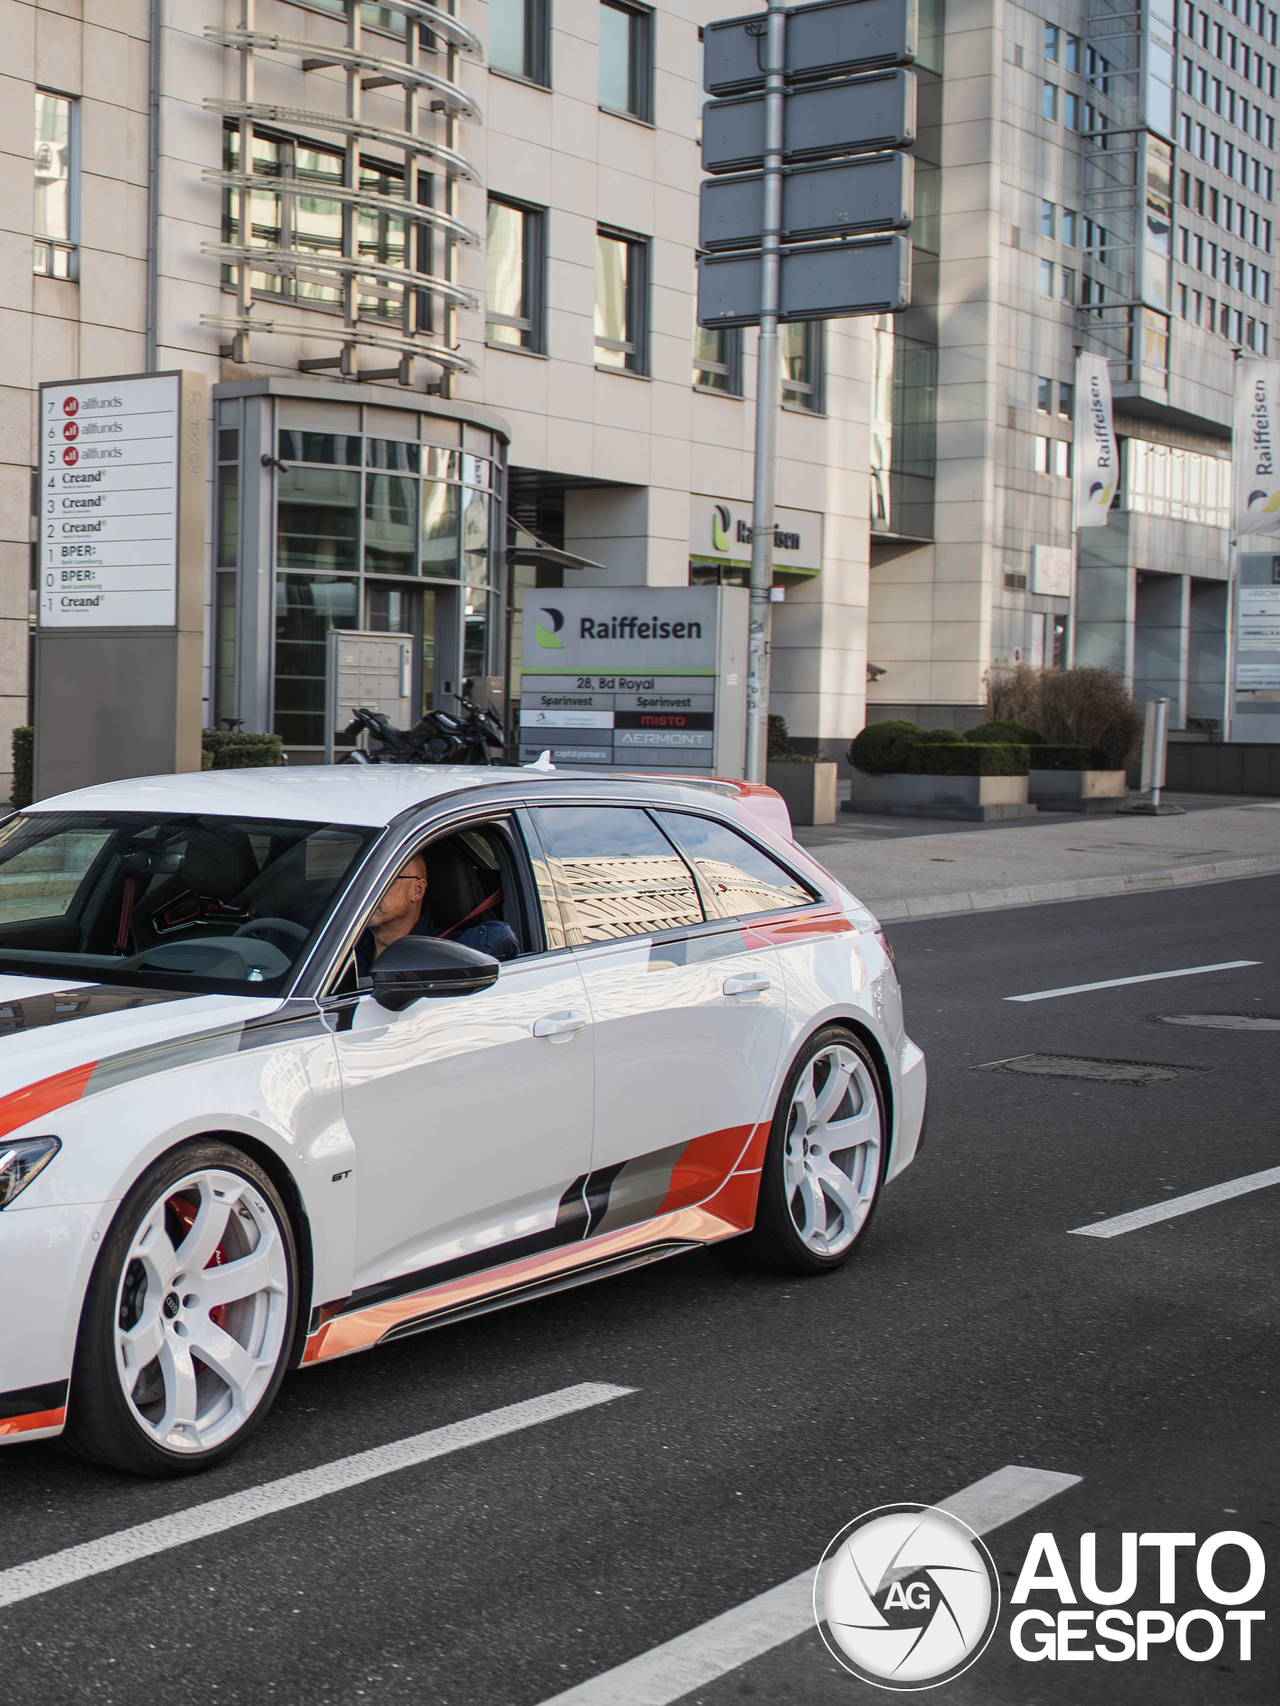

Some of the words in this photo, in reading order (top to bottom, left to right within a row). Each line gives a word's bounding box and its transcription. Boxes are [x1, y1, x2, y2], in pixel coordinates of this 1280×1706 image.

[48, 402, 55, 413] 7
[81, 396, 122, 410] allfunds
[1091, 376, 1110, 467] Raiffeisen
[1251, 380, 1273, 475] Raiffeisen
[48, 427, 55, 438] 6
[81, 422, 122, 435] allfunds
[47, 450, 55, 464] 5
[81, 447, 122, 460] allfunds
[47, 476, 55, 488] 4
[47, 500, 55, 513] 3
[47, 524, 55, 538] 2
[737, 519, 799, 550] Raisen
[46, 573, 54, 587] 0
[580, 616, 702, 639] Raiffeisen
[577, 678, 595, 690] 28,
[599, 678, 615, 689] Bd
[619, 678, 655, 691] Royal
[541, 695, 593, 707] Sparinvest
[636, 697, 691, 708] Sparinvest
[622, 733, 705, 745] AERMONT
